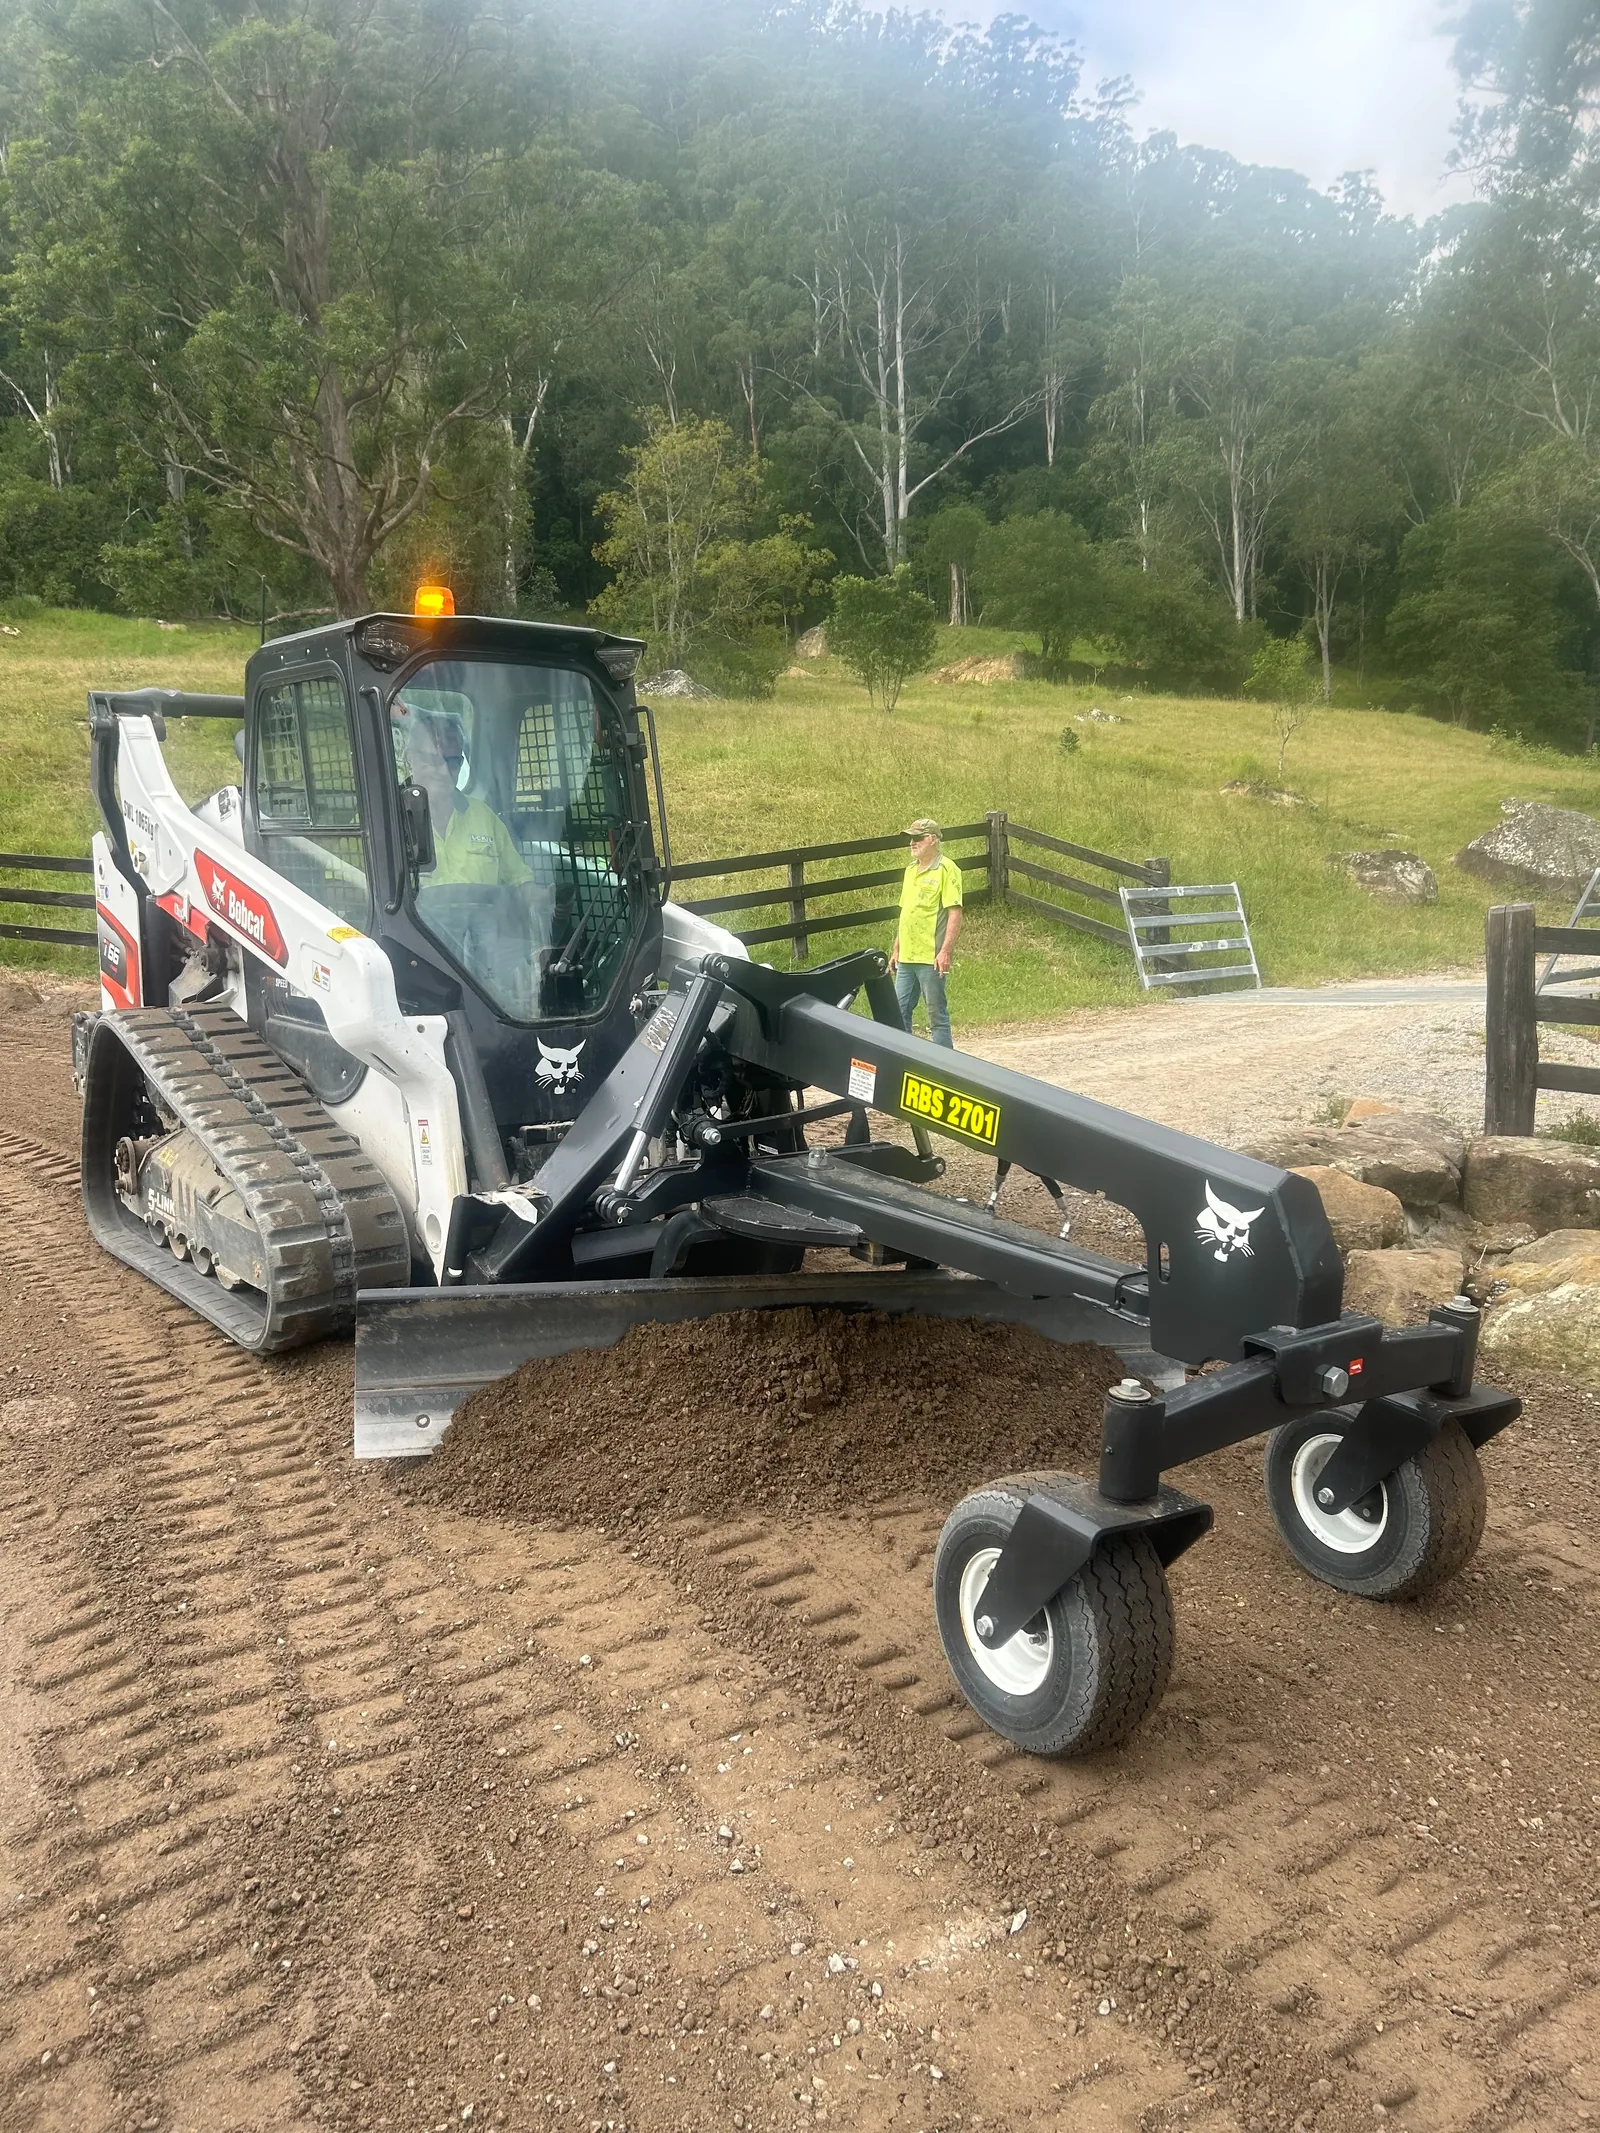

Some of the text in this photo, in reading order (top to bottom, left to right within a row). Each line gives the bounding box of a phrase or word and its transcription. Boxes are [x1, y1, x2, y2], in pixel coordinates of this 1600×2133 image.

[229, 889, 265, 944] Bobcat
[103, 938, 120, 965] T66
[905, 1079, 944, 1118] RBS
[947, 1096, 994, 1138] 2701
